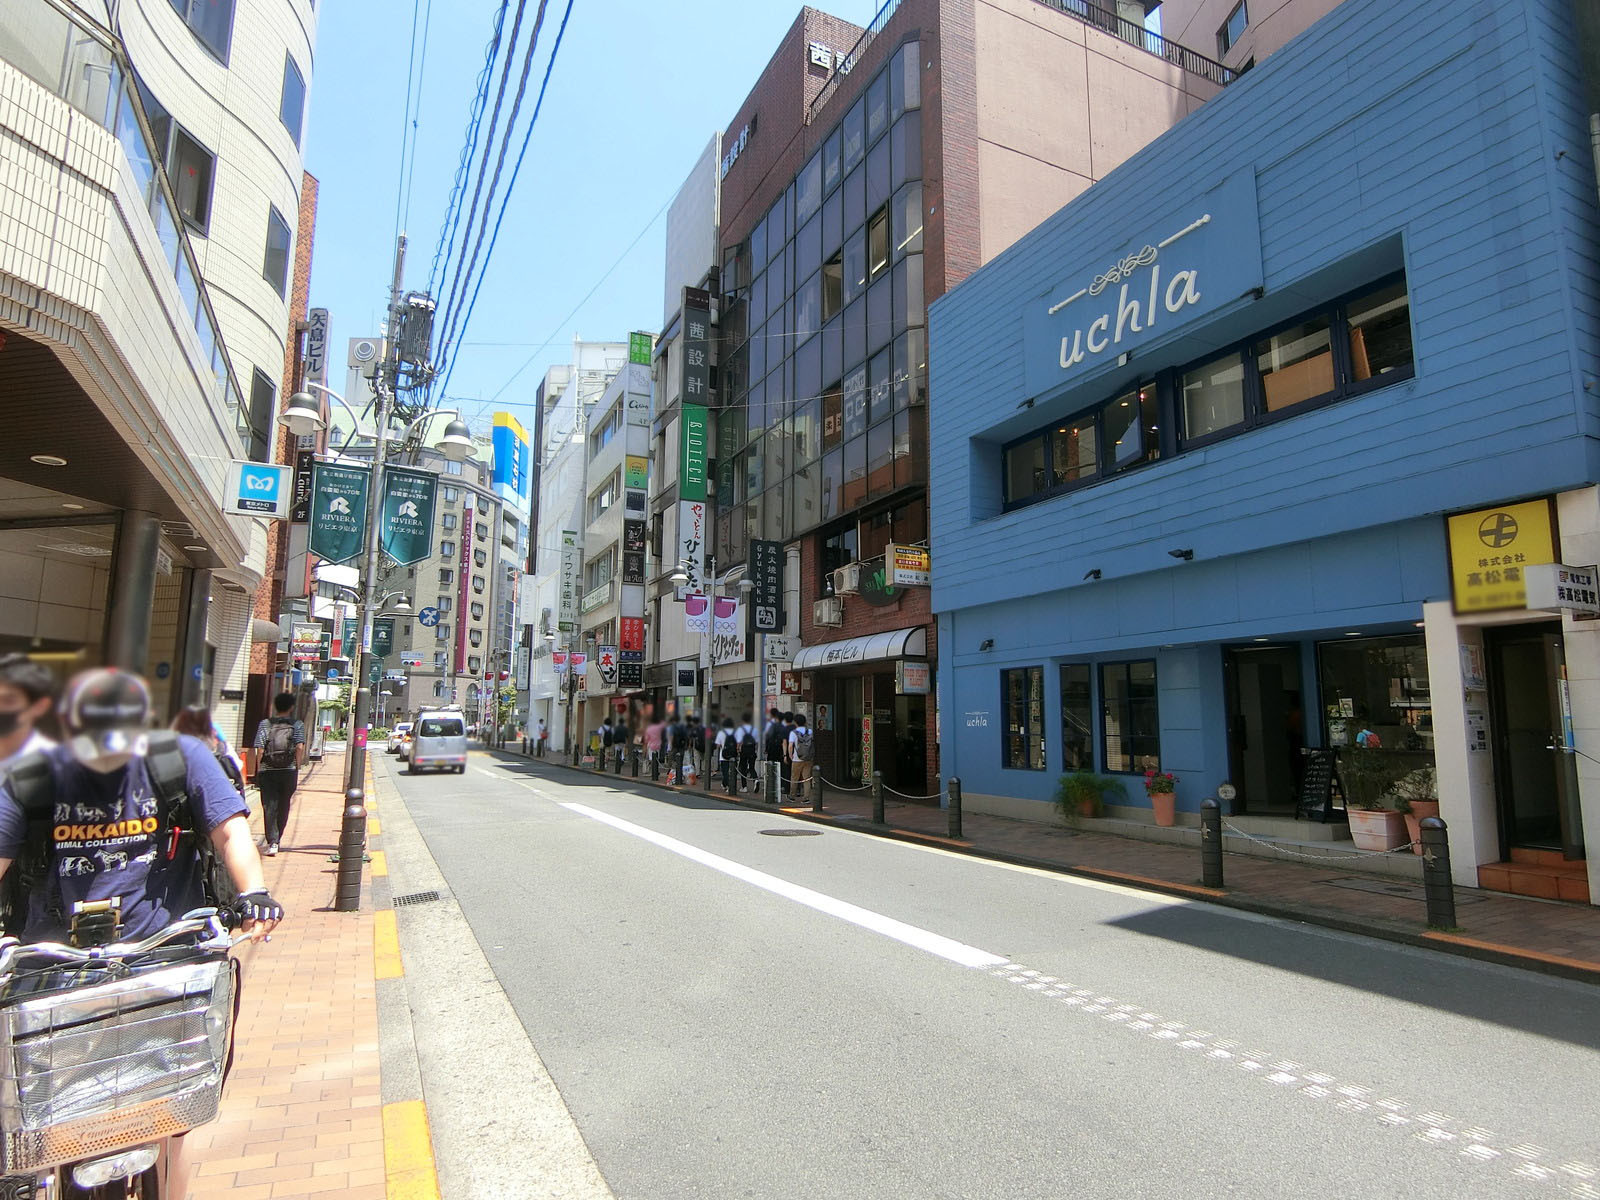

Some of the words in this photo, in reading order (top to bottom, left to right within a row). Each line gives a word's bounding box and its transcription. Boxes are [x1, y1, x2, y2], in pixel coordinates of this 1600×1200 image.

[1059, 265, 1201, 369] uchla
[307, 313, 325, 373] 矢島ビル
[687, 321, 704, 394] 茜設計
[688, 421, 703, 484] BIOTECH
[321, 513, 356, 523] RIVIERA
[391, 516, 423, 527] RIVIERA
[1478, 552, 1526, 567] 株式会社
[562, 552, 573, 609] イワサキ歯科
[966, 715, 988, 727] uchla
[54, 817, 158, 840] OKKAIDO
[85, 834, 147, 847] COLLECTION
